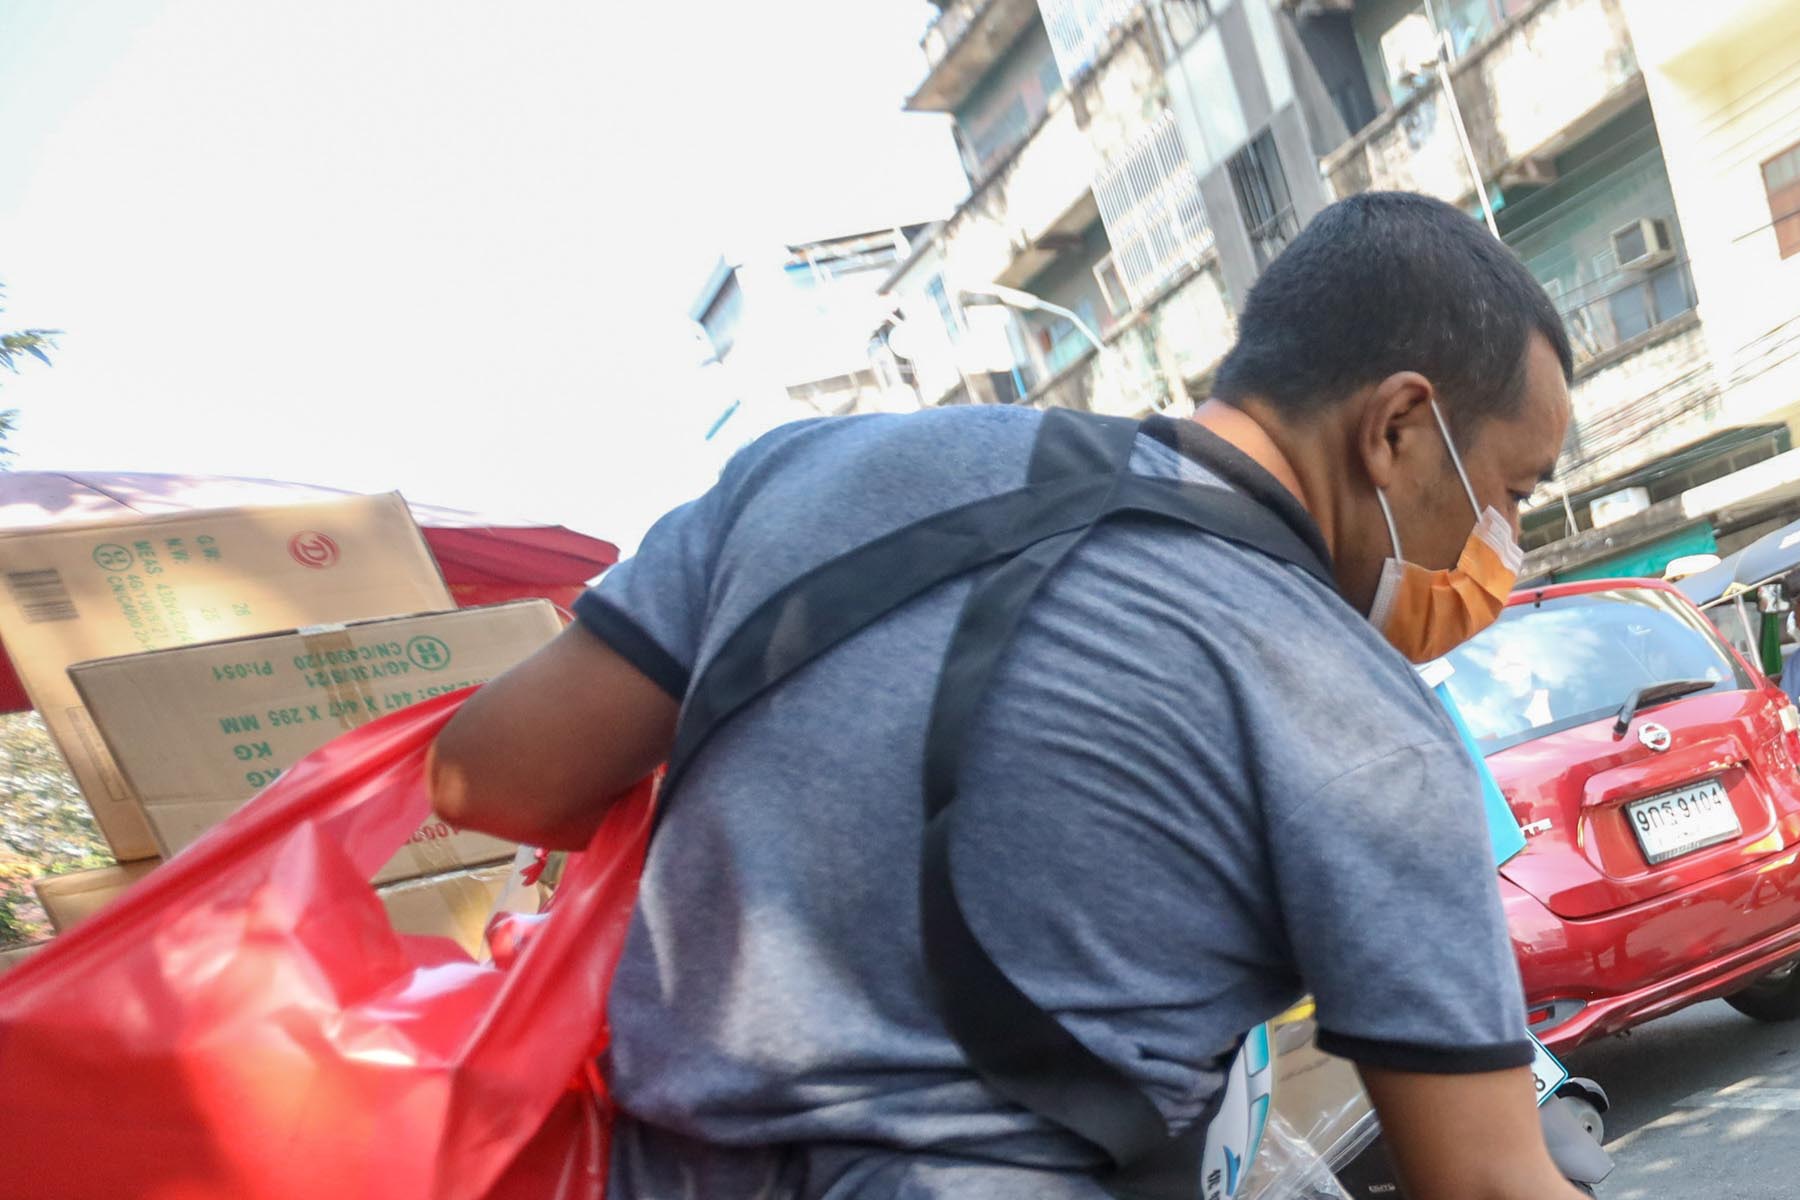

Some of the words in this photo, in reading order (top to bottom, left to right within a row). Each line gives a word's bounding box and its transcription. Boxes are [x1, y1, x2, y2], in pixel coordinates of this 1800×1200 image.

[267, 707, 301, 727] 295
[308, 704, 321, 721] X
[219, 714, 261, 734] MM
[233, 741, 273, 761] KG
[1678, 786, 1722, 819] 9104
